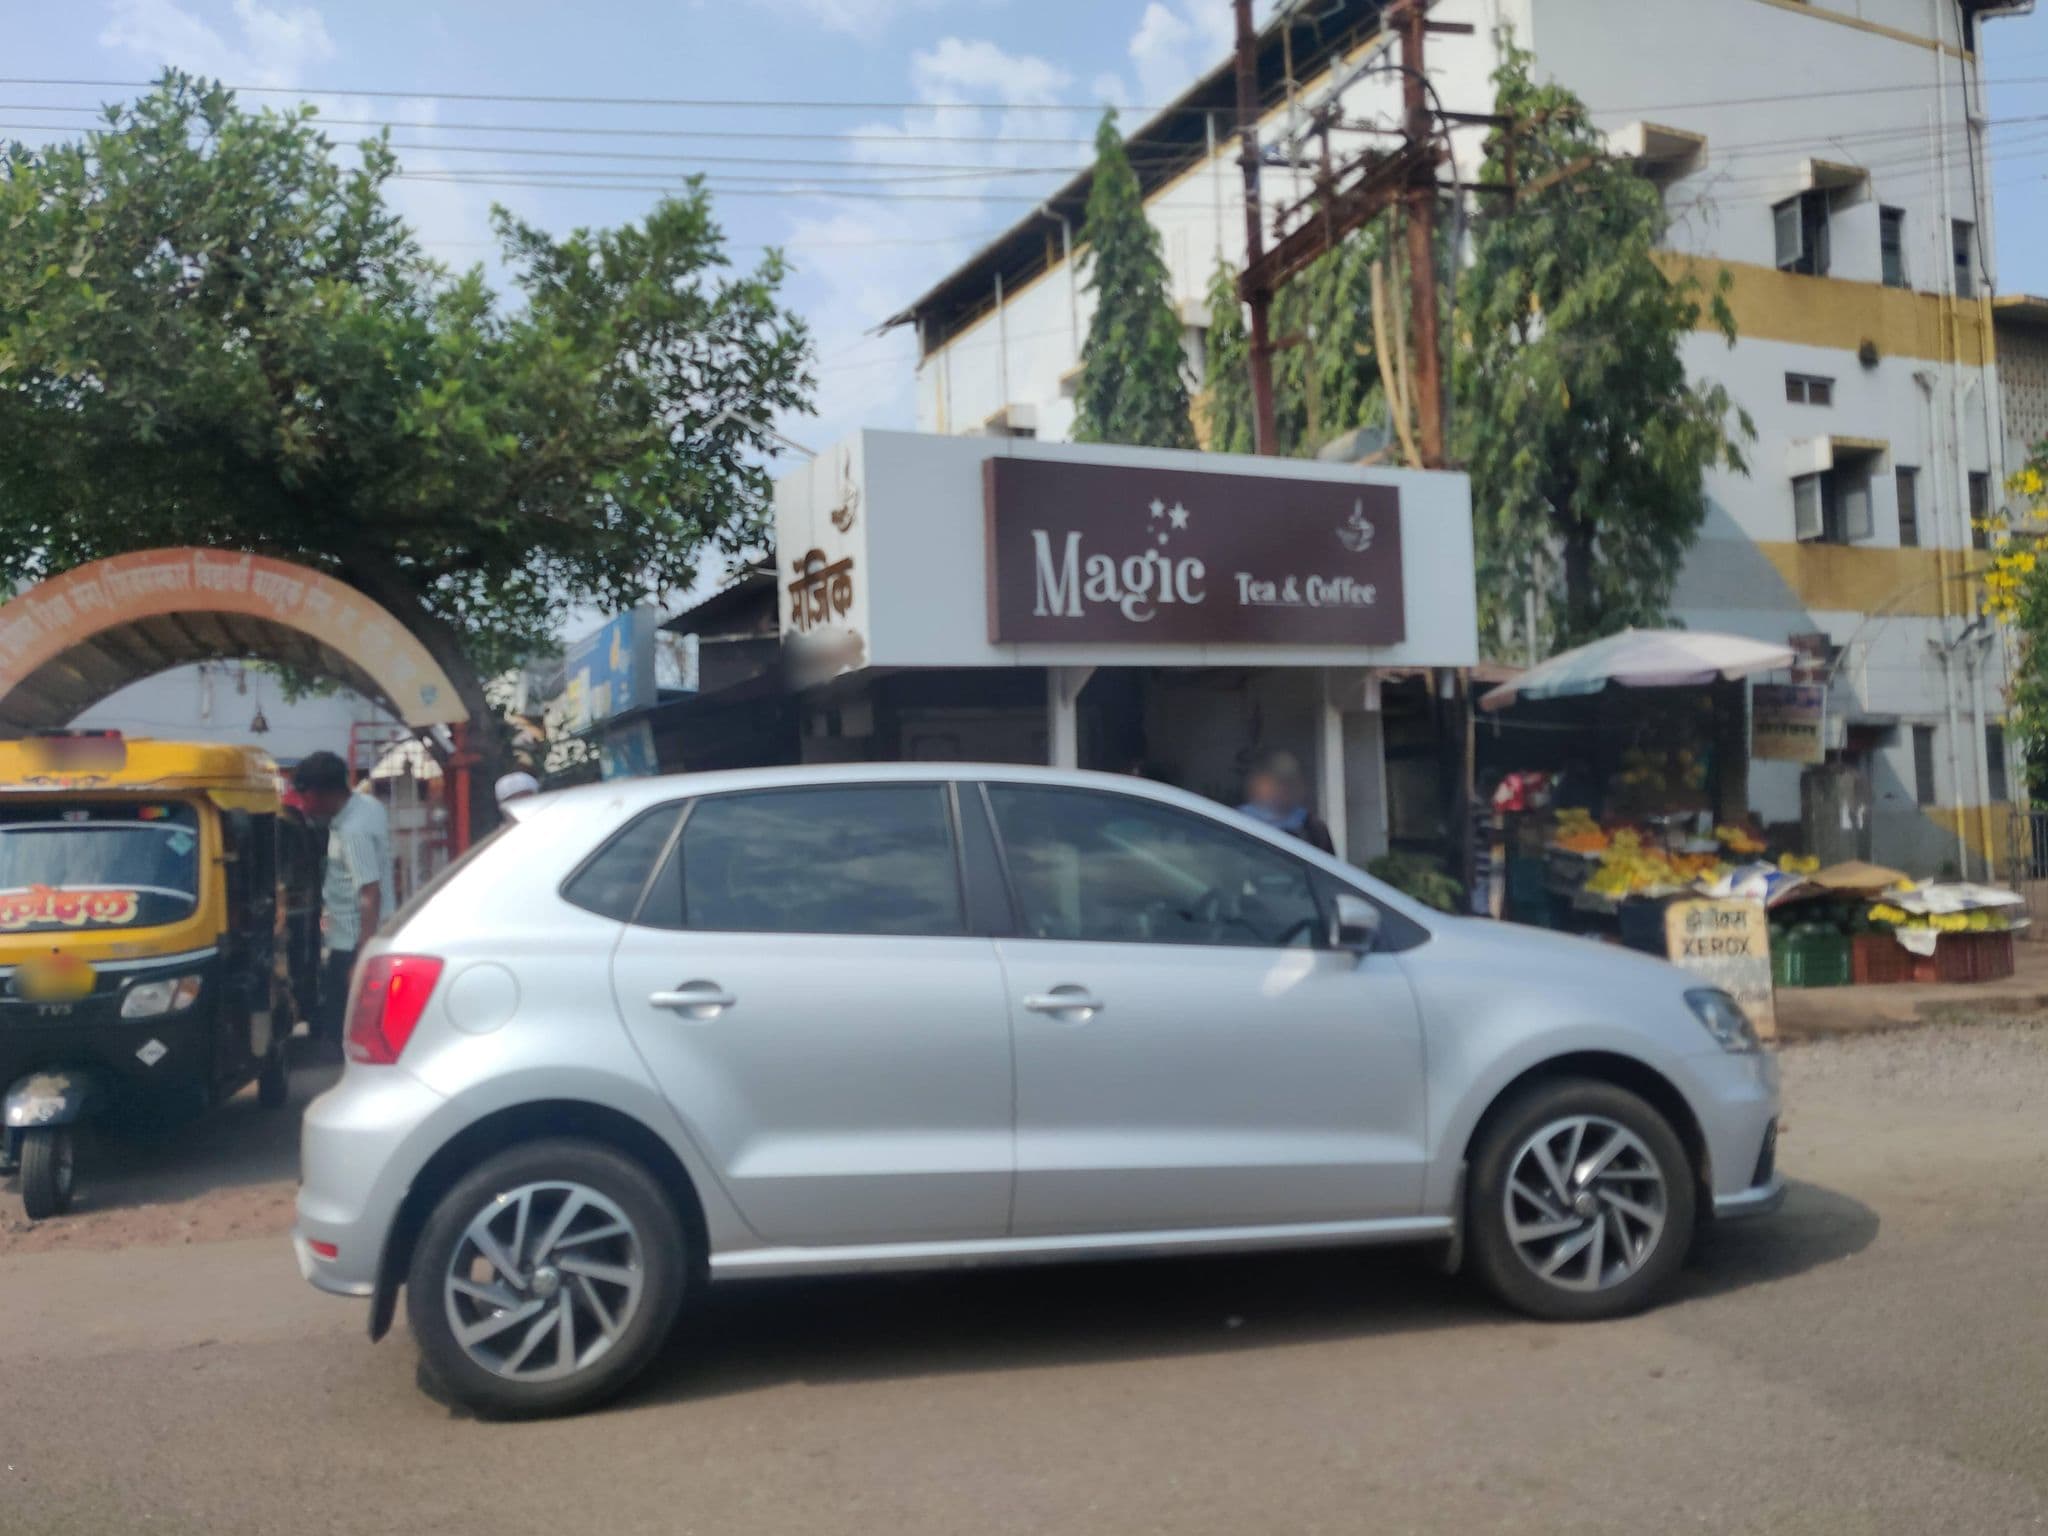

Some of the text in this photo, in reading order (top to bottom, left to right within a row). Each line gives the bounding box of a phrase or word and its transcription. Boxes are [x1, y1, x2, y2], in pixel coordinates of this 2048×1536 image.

[1031, 529, 1206, 622] Magic
[1235, 571, 1377, 607] Tea & Coffee
[1682, 935, 1752, 957] XEROX
